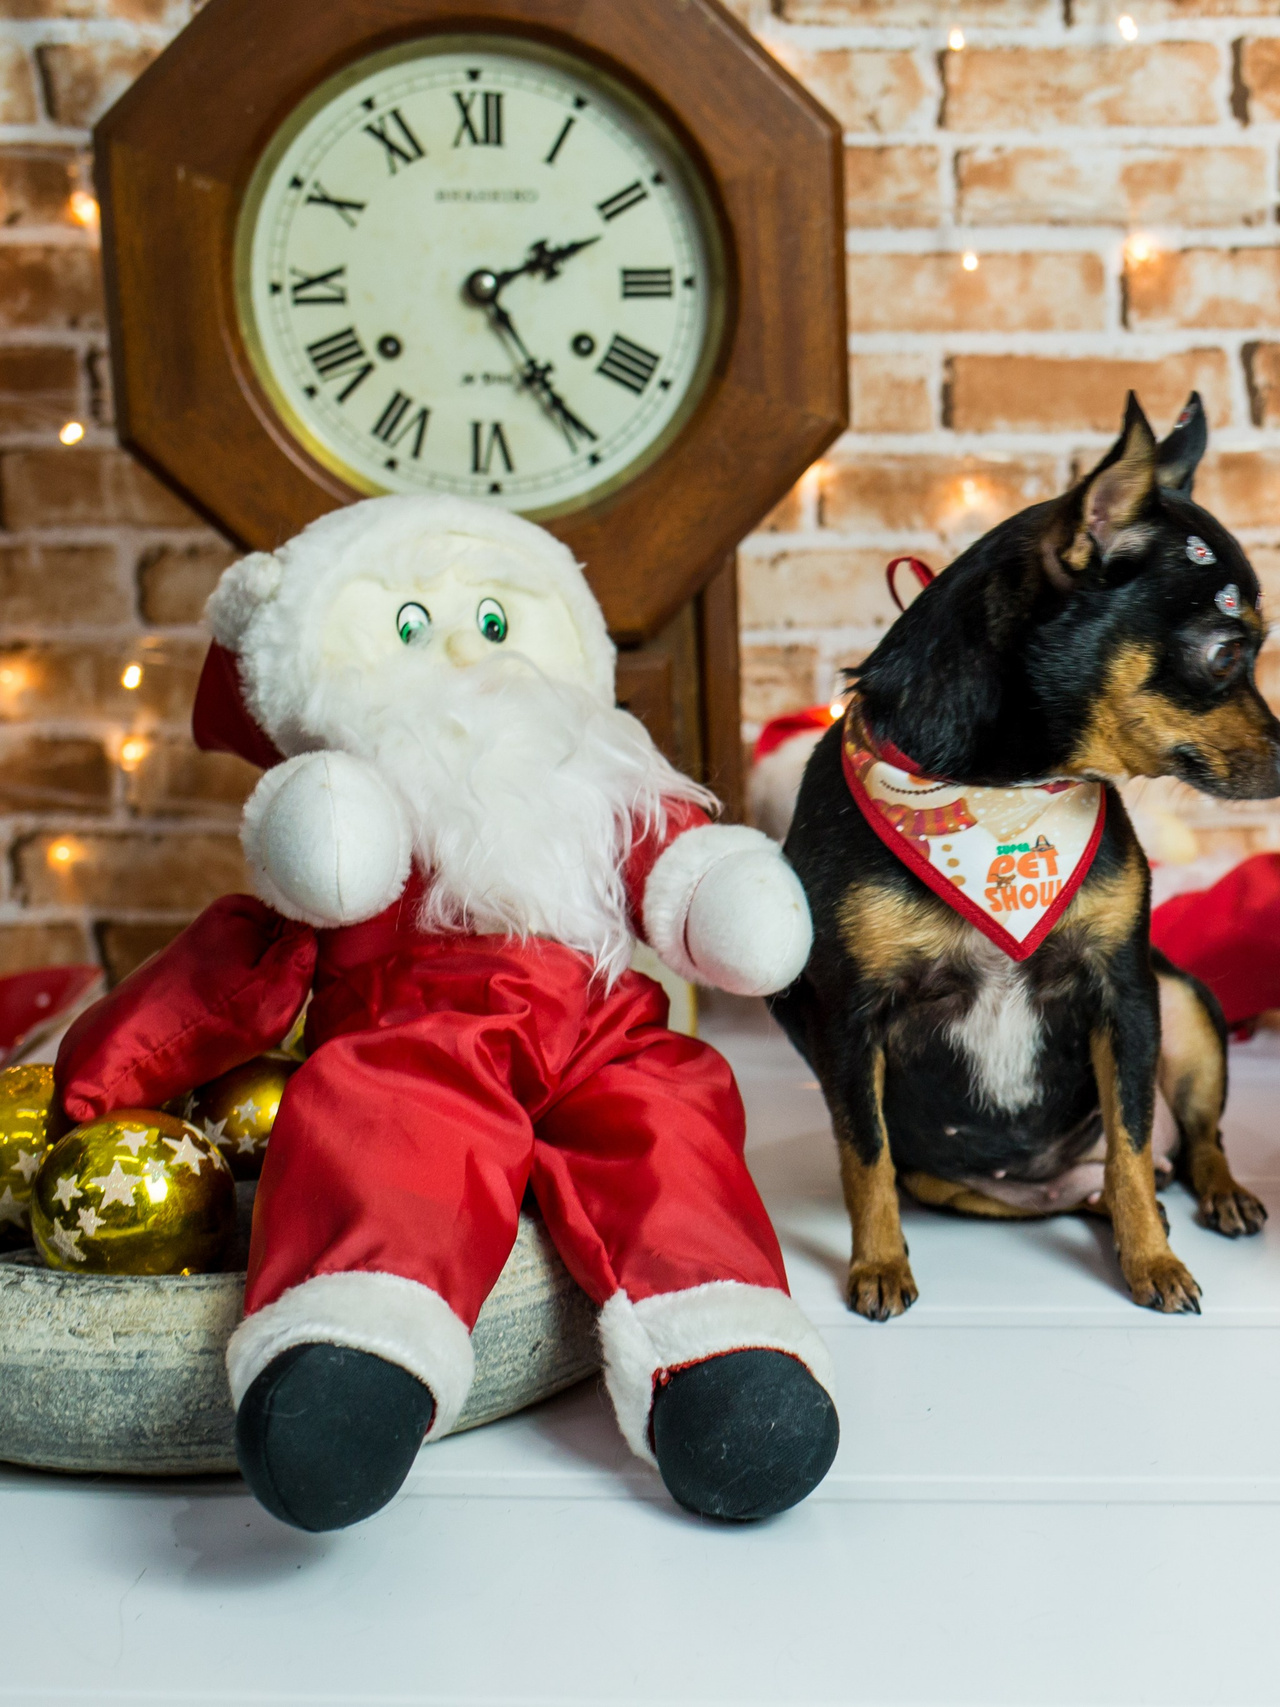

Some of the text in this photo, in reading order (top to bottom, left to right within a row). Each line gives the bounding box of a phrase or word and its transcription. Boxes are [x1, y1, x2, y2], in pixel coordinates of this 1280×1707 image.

[363, 108, 426, 176] XI
[452, 90, 504, 148] XII
[545, 115, 577, 166] I
[304, 181, 367, 228] X
[597, 180, 649, 222] II
[290, 265, 347, 306] IX
[620, 267, 674, 300] III
[306, 328, 374, 403] VIII
[596, 333, 661, 397] IIII
[371, 391, 432, 460] VII
[469, 421, 515, 474] VI
[987, 849, 1058, 883] PET
[985, 880, 1061, 912] SHOW
